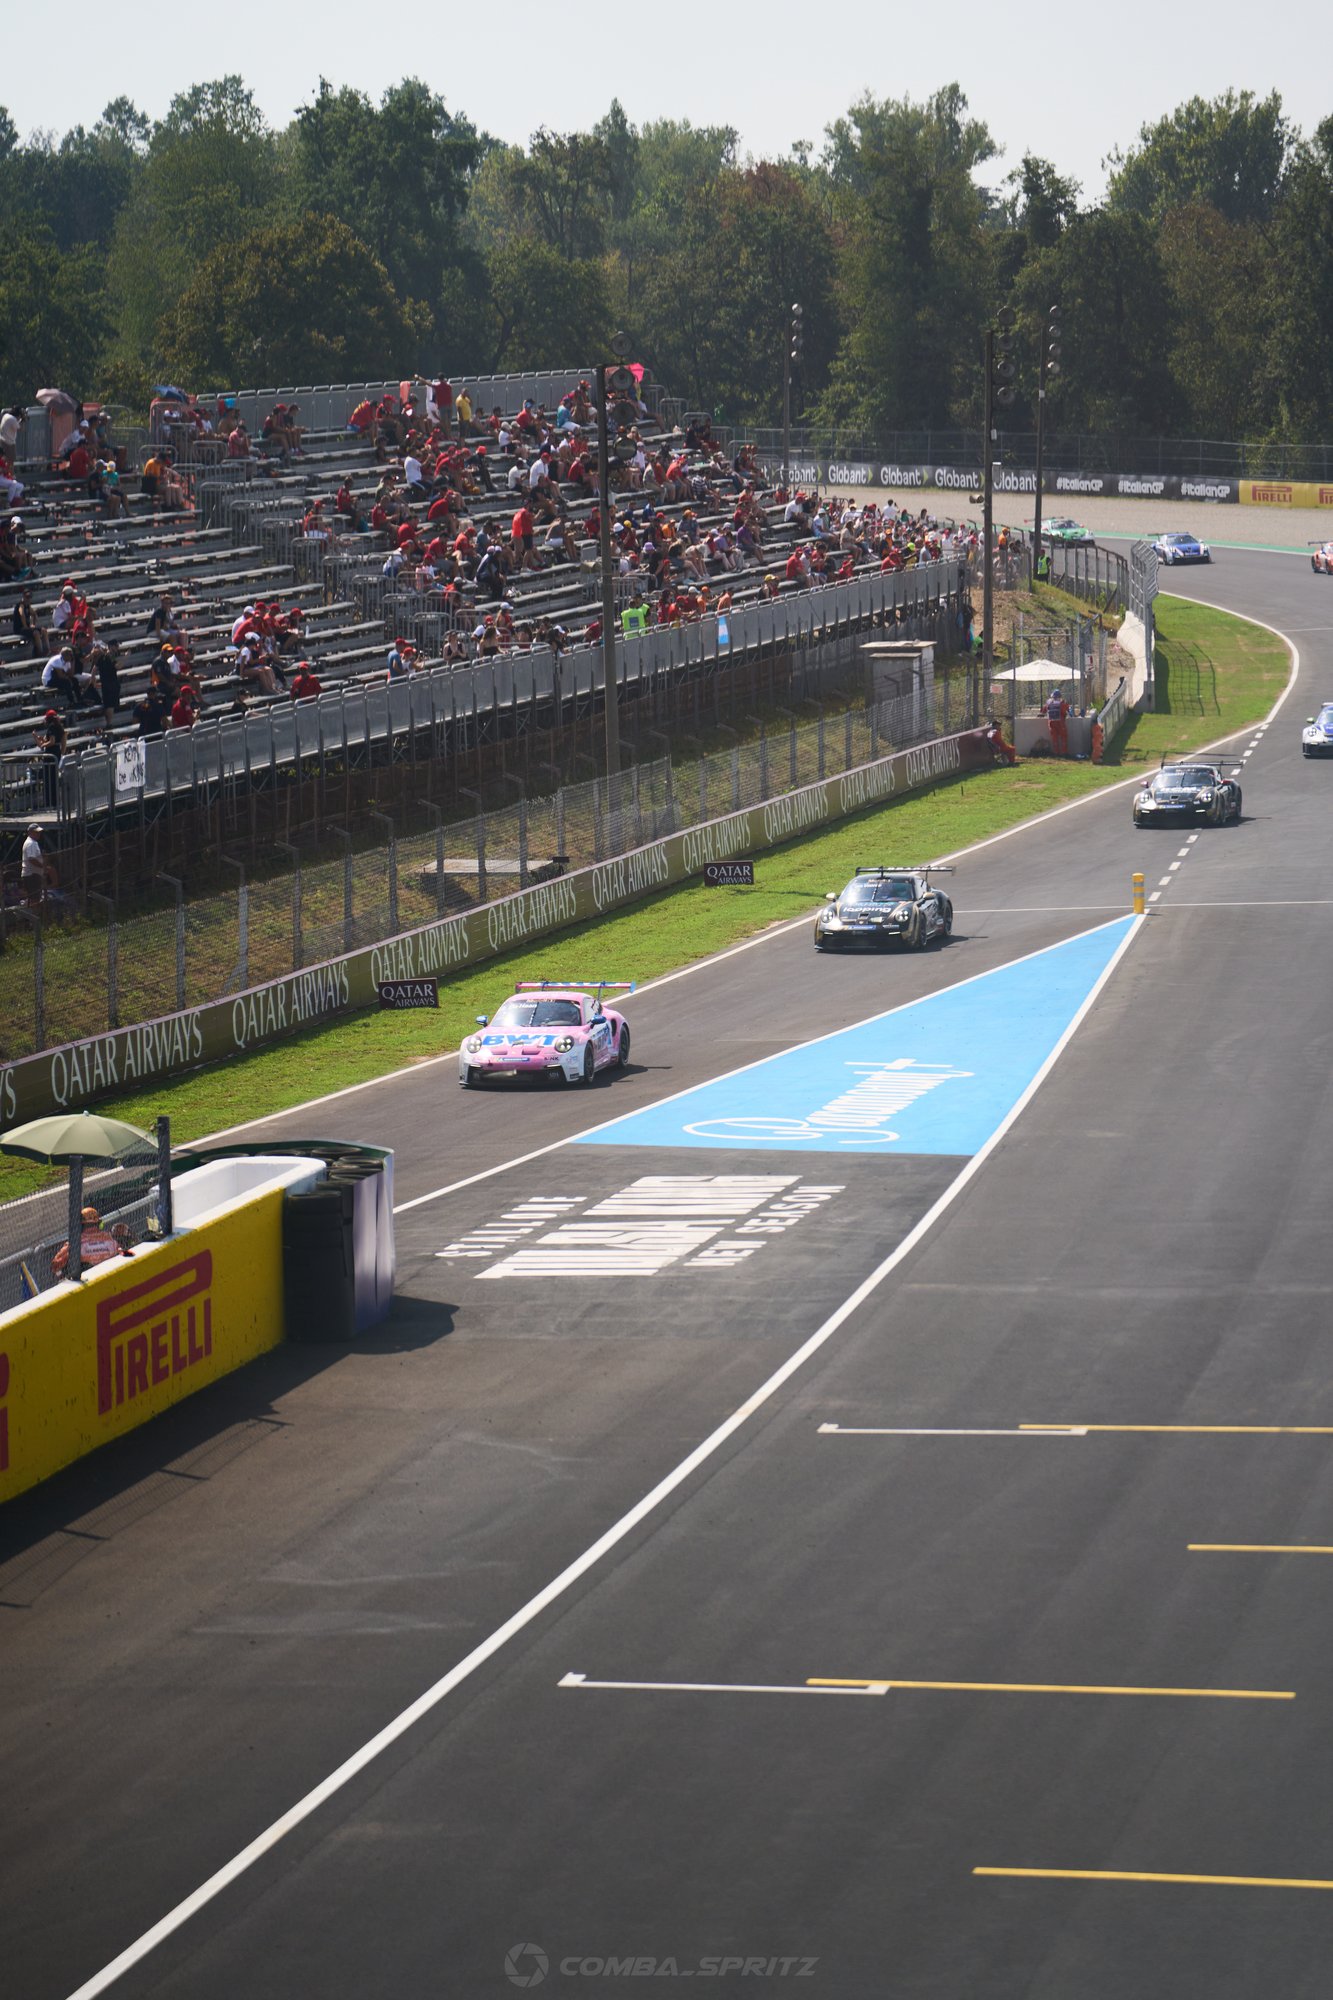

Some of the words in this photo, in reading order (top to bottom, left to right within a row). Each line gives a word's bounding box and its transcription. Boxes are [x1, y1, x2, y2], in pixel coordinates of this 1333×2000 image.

[828, 464, 867, 484] Globant
[880, 465, 921, 486] Globant
[935, 468, 979, 489] Globant
[1252, 485, 1293, 503] PIRELLI
[905, 747, 931, 787] QATAR
[840, 771, 866, 814] QATAR
[764, 798, 794, 843] QATAR
[683, 826, 714, 875] QATAR
[715, 812, 751, 859] AIRWAYS
[592, 859, 627, 911] QATAR
[628, 843, 669, 894] AIRWAYS
[706, 865, 751, 880] QATAR
[717, 876, 752, 885] AIRWAYS
[488, 895, 527, 951] QATAR
[529, 877, 577, 932] AIRWAYS
[843, 903, 892, 913] looping
[370, 936, 415, 993] QATAR
[417, 917, 468, 975] AIRWAYS
[232, 983, 287, 1049] QATAR
[290, 960, 349, 1024] AIRWAYS
[381, 983, 434, 1002] QATAR
[395, 997, 435, 1008] AIRWAYS
[51, 1036, 119, 1106] QATAR
[123, 1011, 202, 1080] AIRWAYS
[482, 1034, 559, 1046] BWT
[581, 1175, 803, 1215] KING
[434, 1196, 588, 1257] STALLONE
[683, 1241, 767, 1266] NEW
[735, 1186, 846, 1234] SEASON
[473, 1219, 736, 1279] TULSA
[97, 1248, 213, 1416] PIRELLI
